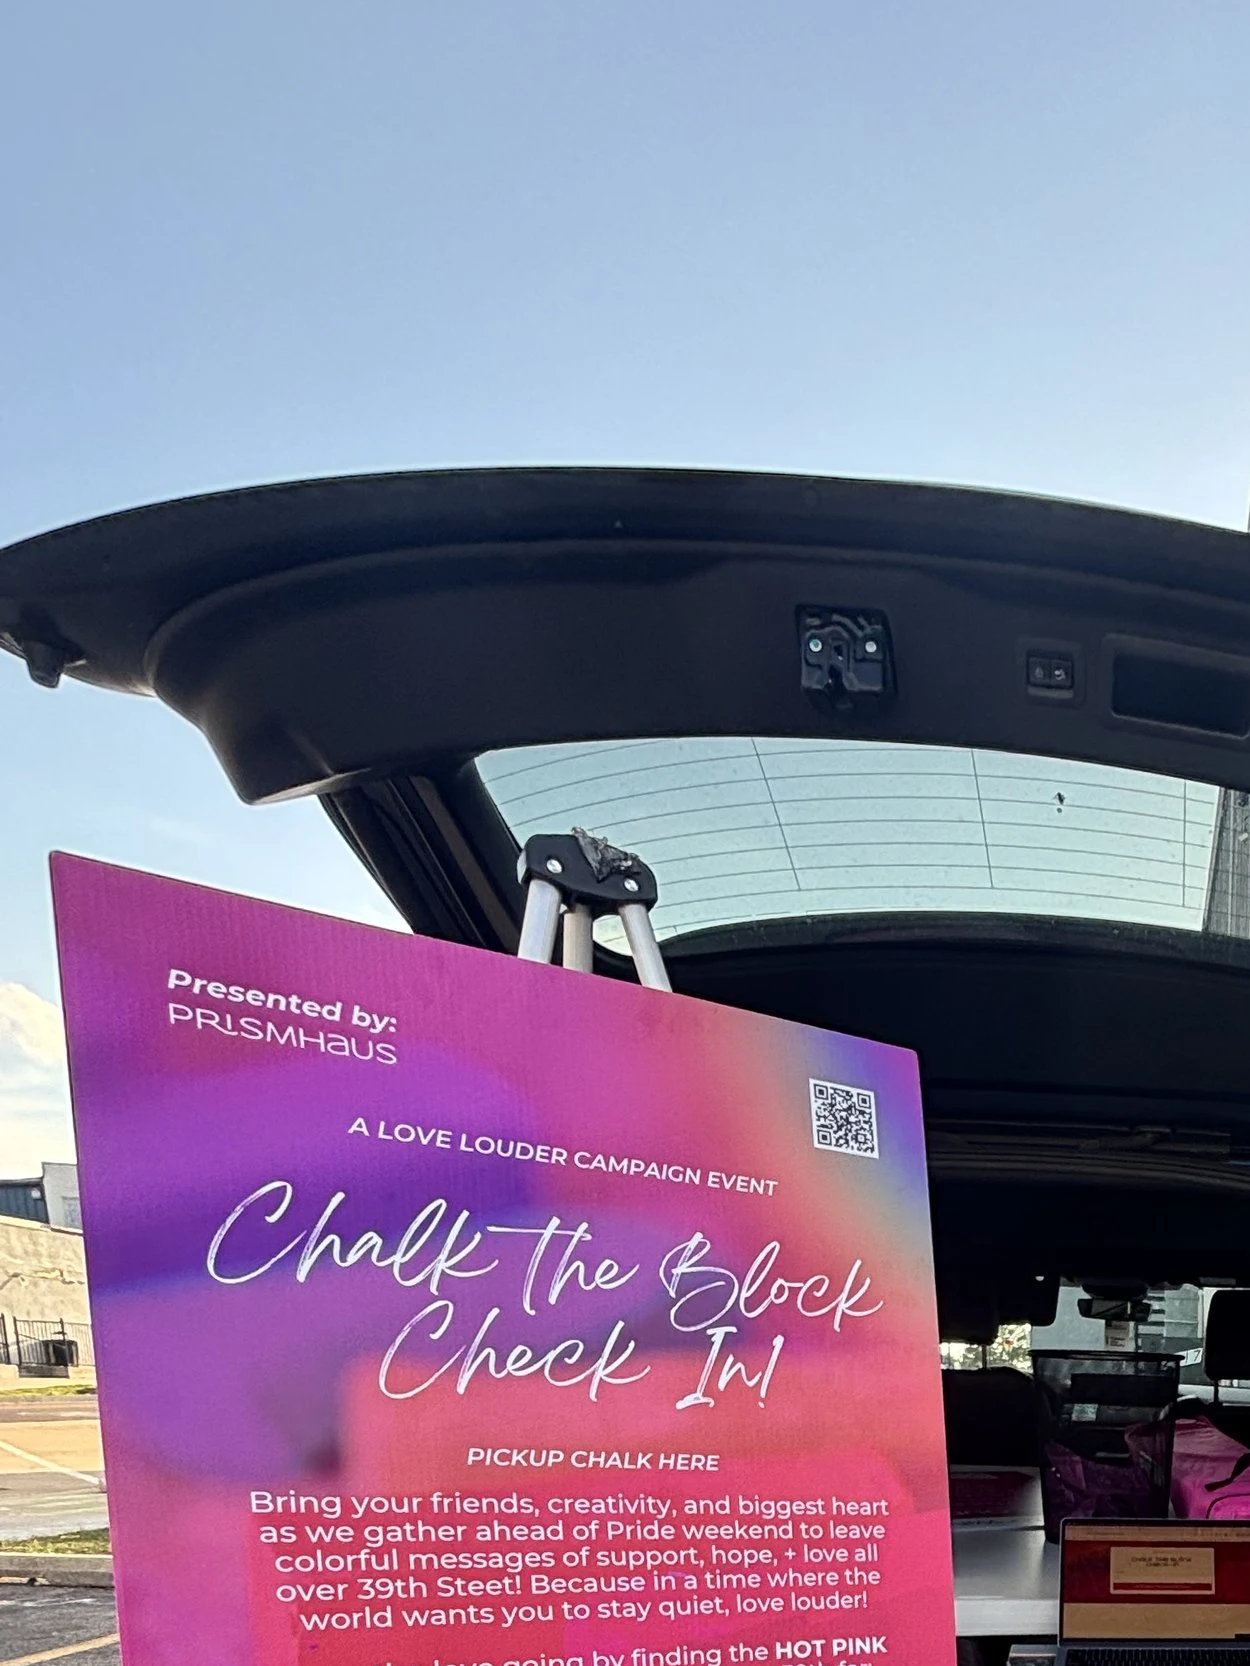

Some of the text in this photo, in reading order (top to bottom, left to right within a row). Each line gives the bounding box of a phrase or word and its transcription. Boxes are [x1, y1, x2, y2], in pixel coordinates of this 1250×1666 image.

[166, 967, 397, 1034] Presented by:
[347, 1116, 779, 1197] A LOVE LOUDER CAMPAIGN EVENT
[206, 1180, 884, 1333] Chalk The Block
[378, 1299, 785, 1410] Check In!
[466, 1447, 720, 1472] PICKUP CHALK HERE
[249, 1489, 890, 1520] Bring your friends, creativity, and biggest heart
[259, 1519, 886, 1548] as we gather ahead of Pride weekend to leave
[274, 1547, 399, 1573] colorful
[408, 1551, 556, 1574] messages
[562, 1545, 591, 1568] of
[596, 1546, 705, 1571] support,
[711, 1544, 778, 1569] hope,
[803, 1543, 849, 1563] love
[854, 1542, 878, 1562] all
[274, 1565, 882, 1603] over 39th Steet! Because in a time where the
[299, 1590, 868, 1631] world wants you to stay quiet, love louder!
[728, 1642, 769, 1663] the
[775, 1638, 827, 1660] HOT
[831, 1635, 888, 1657] PINK
